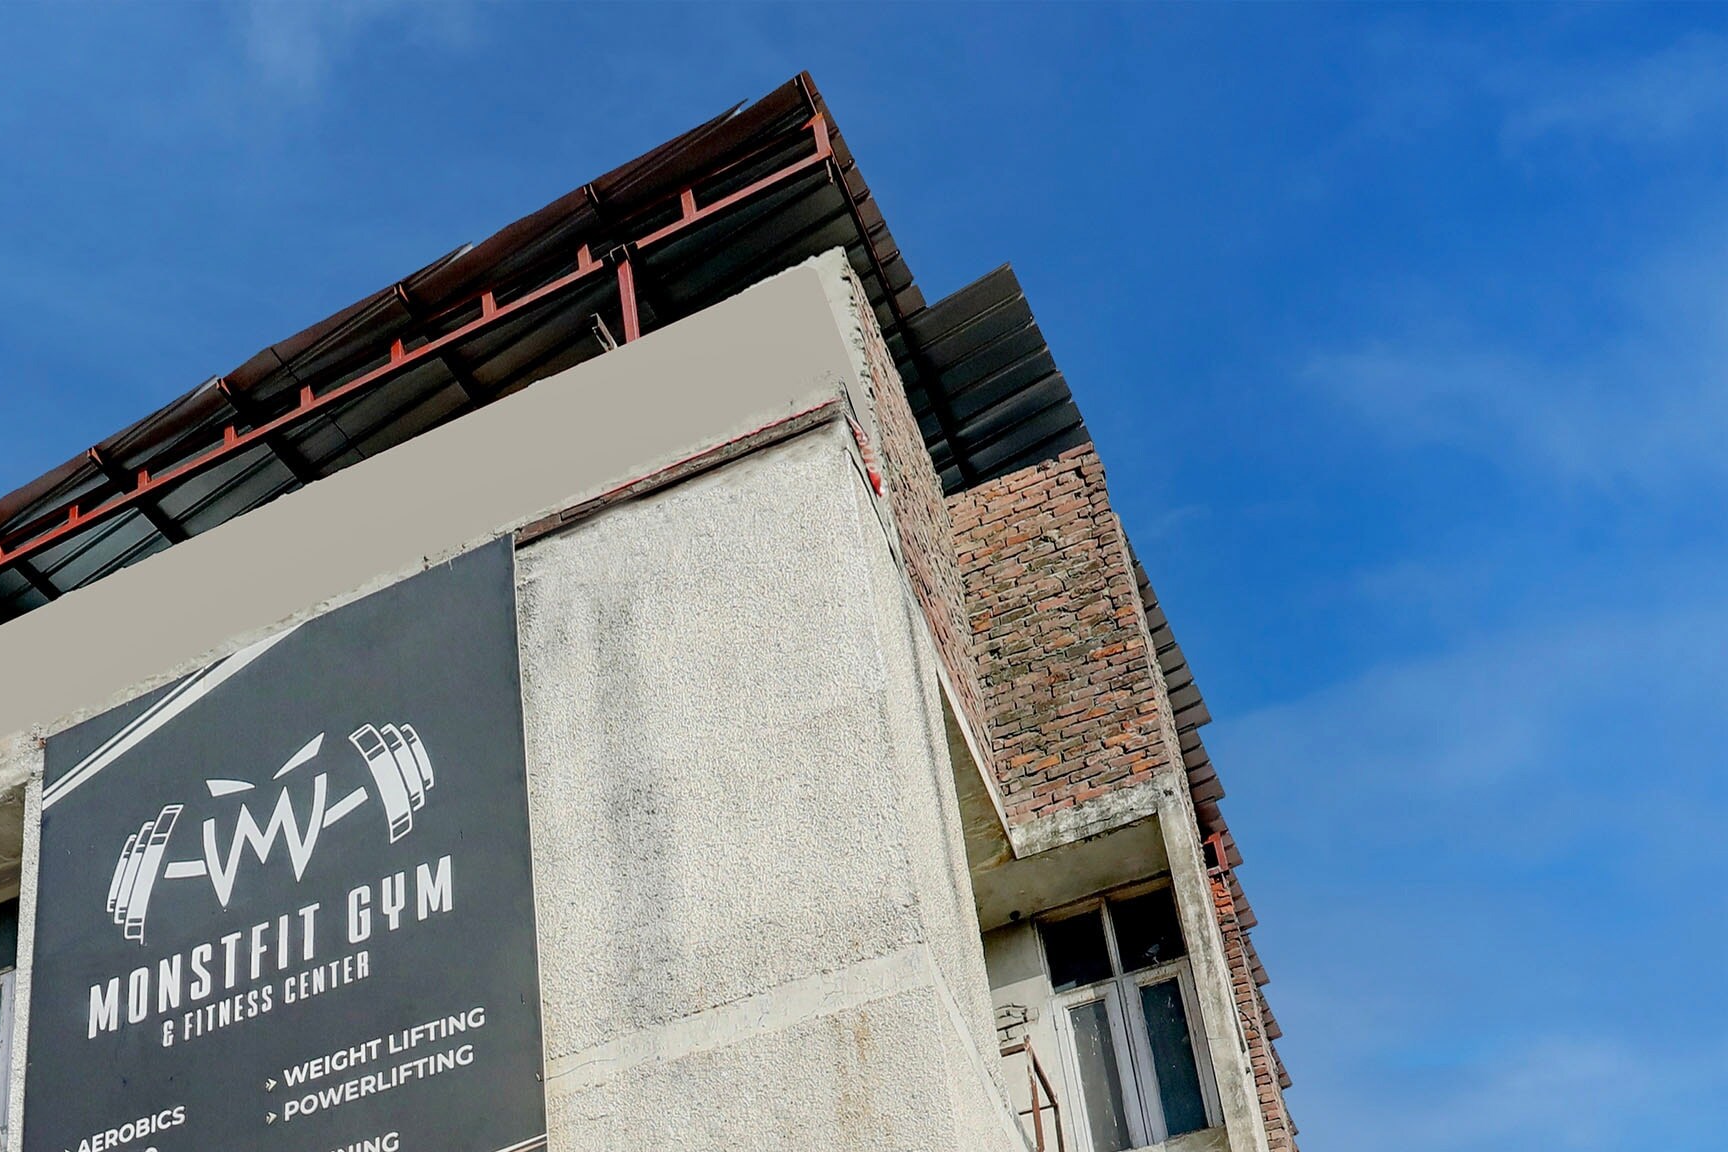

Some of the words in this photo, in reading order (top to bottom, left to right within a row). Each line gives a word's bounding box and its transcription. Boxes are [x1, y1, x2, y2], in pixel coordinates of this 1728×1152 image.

[88, 902, 320, 1040] MONSTFIT
[348, 855, 453, 944] GYM
[162, 1019, 175, 1048] &
[182, 986, 273, 1037] FITNESS
[284, 951, 370, 1004] CENTER
[283, 1037, 381, 1088] WEIGHT
[388, 1006, 487, 1055] LIFTING
[283, 1043, 475, 1122] POWERLIFTING
